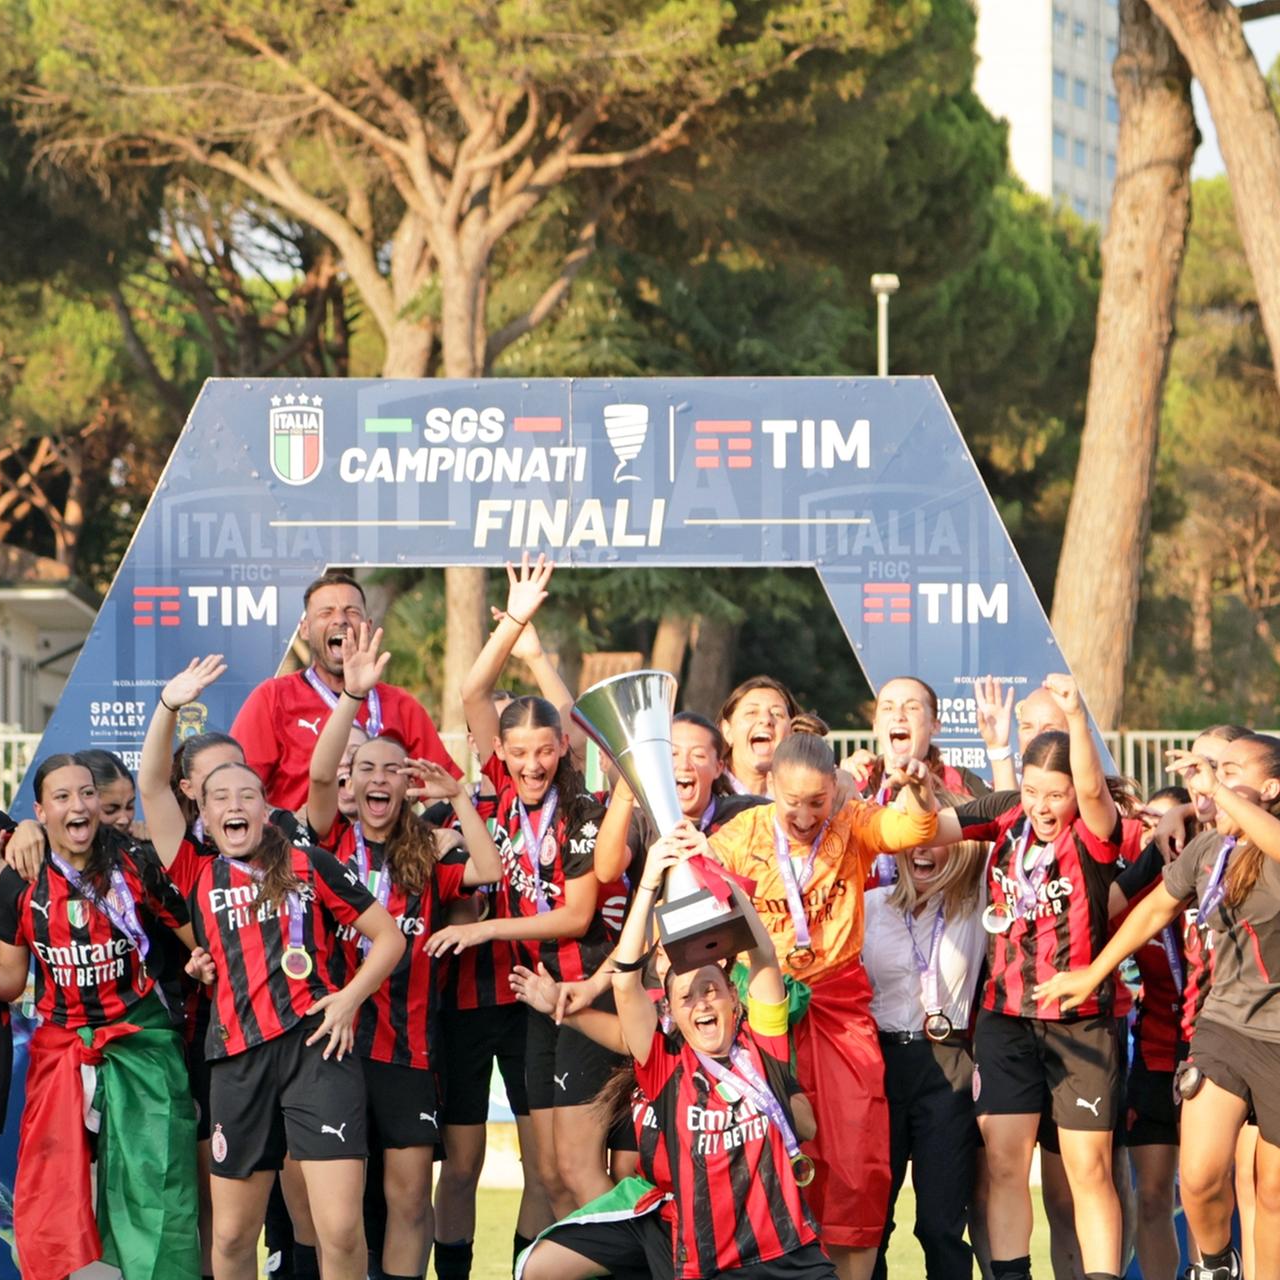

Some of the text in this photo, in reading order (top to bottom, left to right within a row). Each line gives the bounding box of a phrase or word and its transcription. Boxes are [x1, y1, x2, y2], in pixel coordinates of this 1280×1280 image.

[274, 412, 319, 430] ITALIA
[424, 407, 505, 443] SGS
[761, 420, 870, 469] TIM
[339, 447, 586, 483] CAMPIONATI
[473, 499, 665, 547] FINALI
[231, 564, 272, 581] FIGC
[188, 586, 278, 627] TIM
[918, 583, 1008, 624] TIM
[90, 702, 145, 714] SPORT
[90, 715, 146, 726] VALLEY
[77, 958, 124, 987] BETTER
[698, 1133, 720, 1155] FLY
